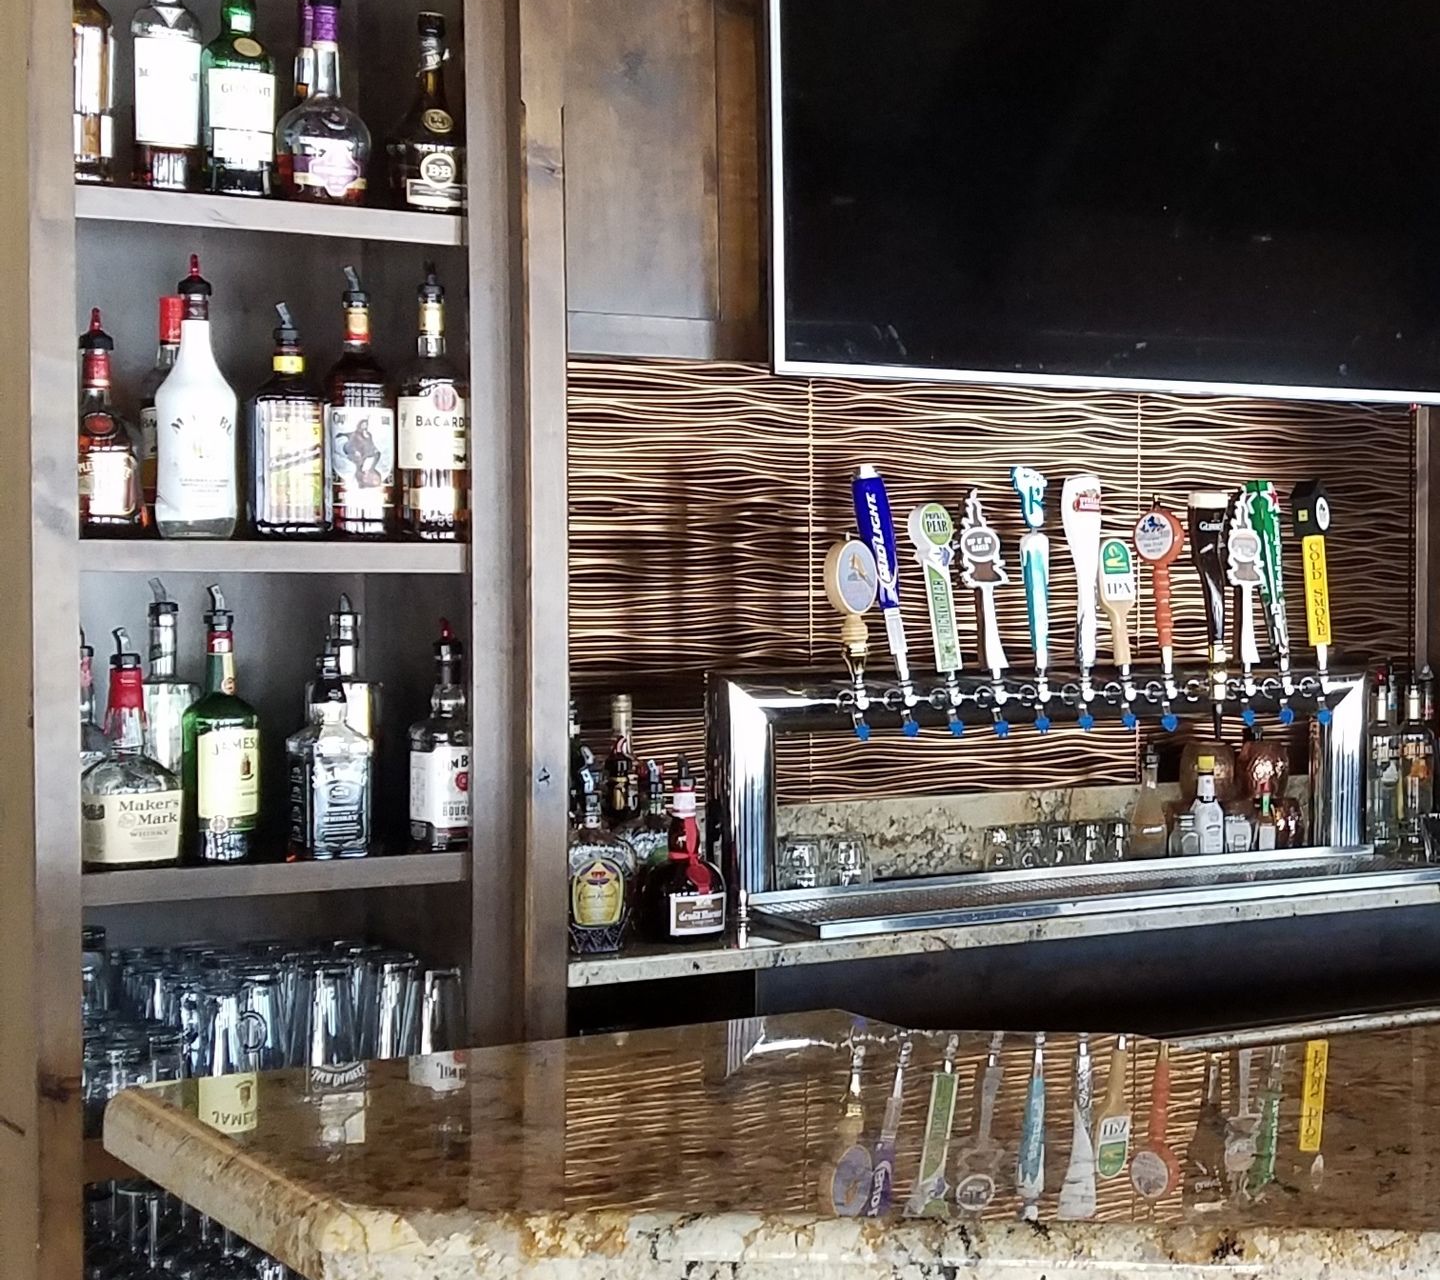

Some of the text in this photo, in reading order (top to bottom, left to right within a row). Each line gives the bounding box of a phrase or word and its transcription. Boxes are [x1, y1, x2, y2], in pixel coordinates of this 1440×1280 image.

[926, 521, 948, 533] PEAR
[1107, 583, 1132, 594] IPA
[1309, 543, 1327, 636] COLD SMOKE
[118, 799, 179, 812] Maker's
[137, 812, 178, 825] Mark
